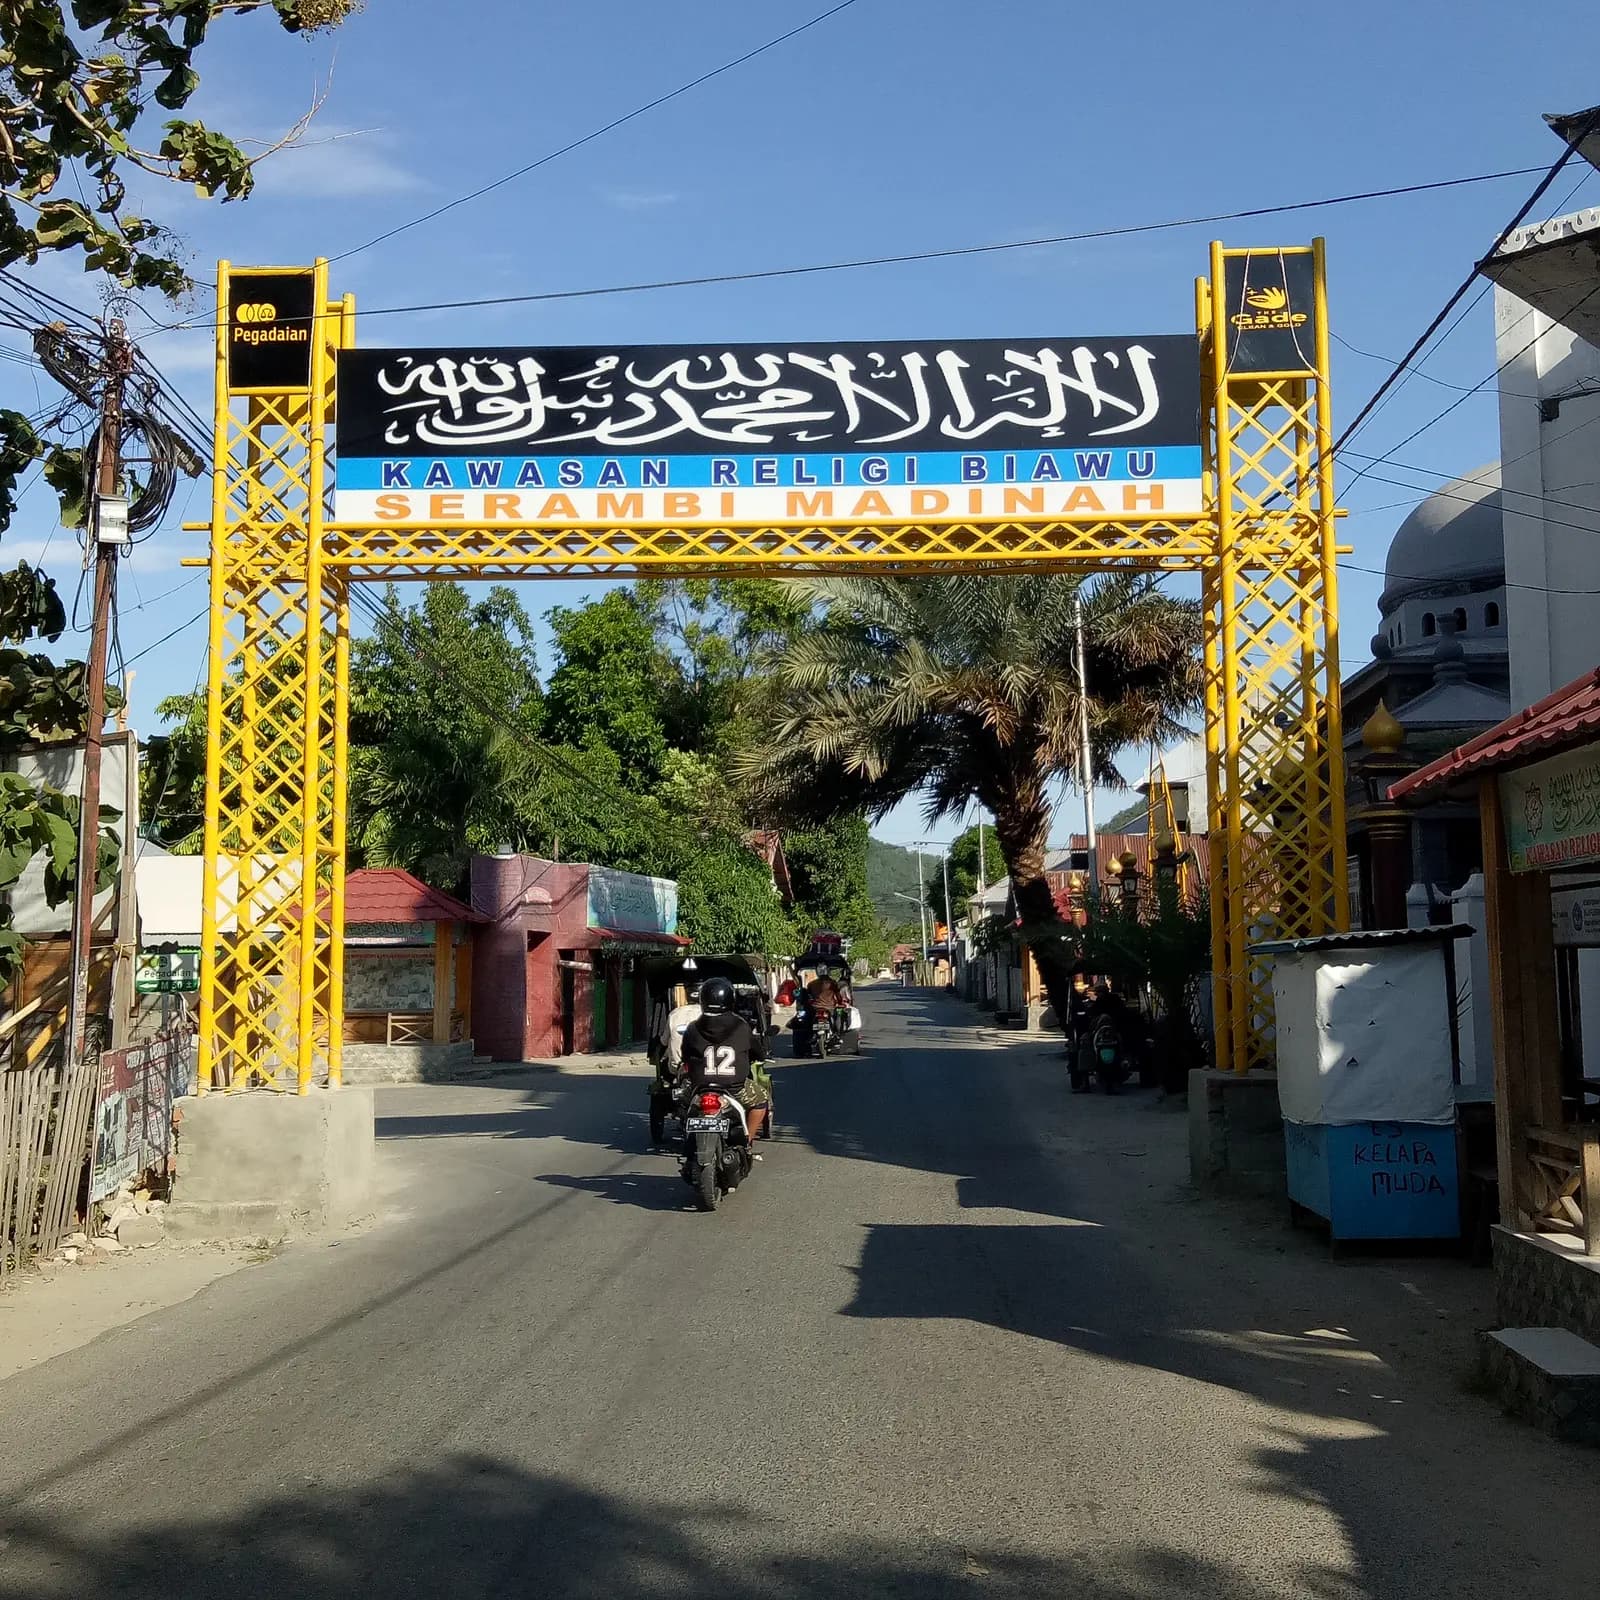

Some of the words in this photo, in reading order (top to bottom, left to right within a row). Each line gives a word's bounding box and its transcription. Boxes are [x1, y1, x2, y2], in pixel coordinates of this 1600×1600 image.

[1230, 311, 1308, 324] Gade
[234, 326, 307, 345] Pegadaian
[382, 459, 669, 488] KAWASAN
[712, 455, 919, 487] RELIGI
[961, 450, 1157, 483] BIAWU
[374, 491, 735, 520] SERAMBI
[786, 484, 1165, 518] MADINAH
[704, 1045, 736, 1076] 12
[1354, 1141, 1436, 1166] KELAPA
[1372, 1172, 1446, 1197] MUDA
